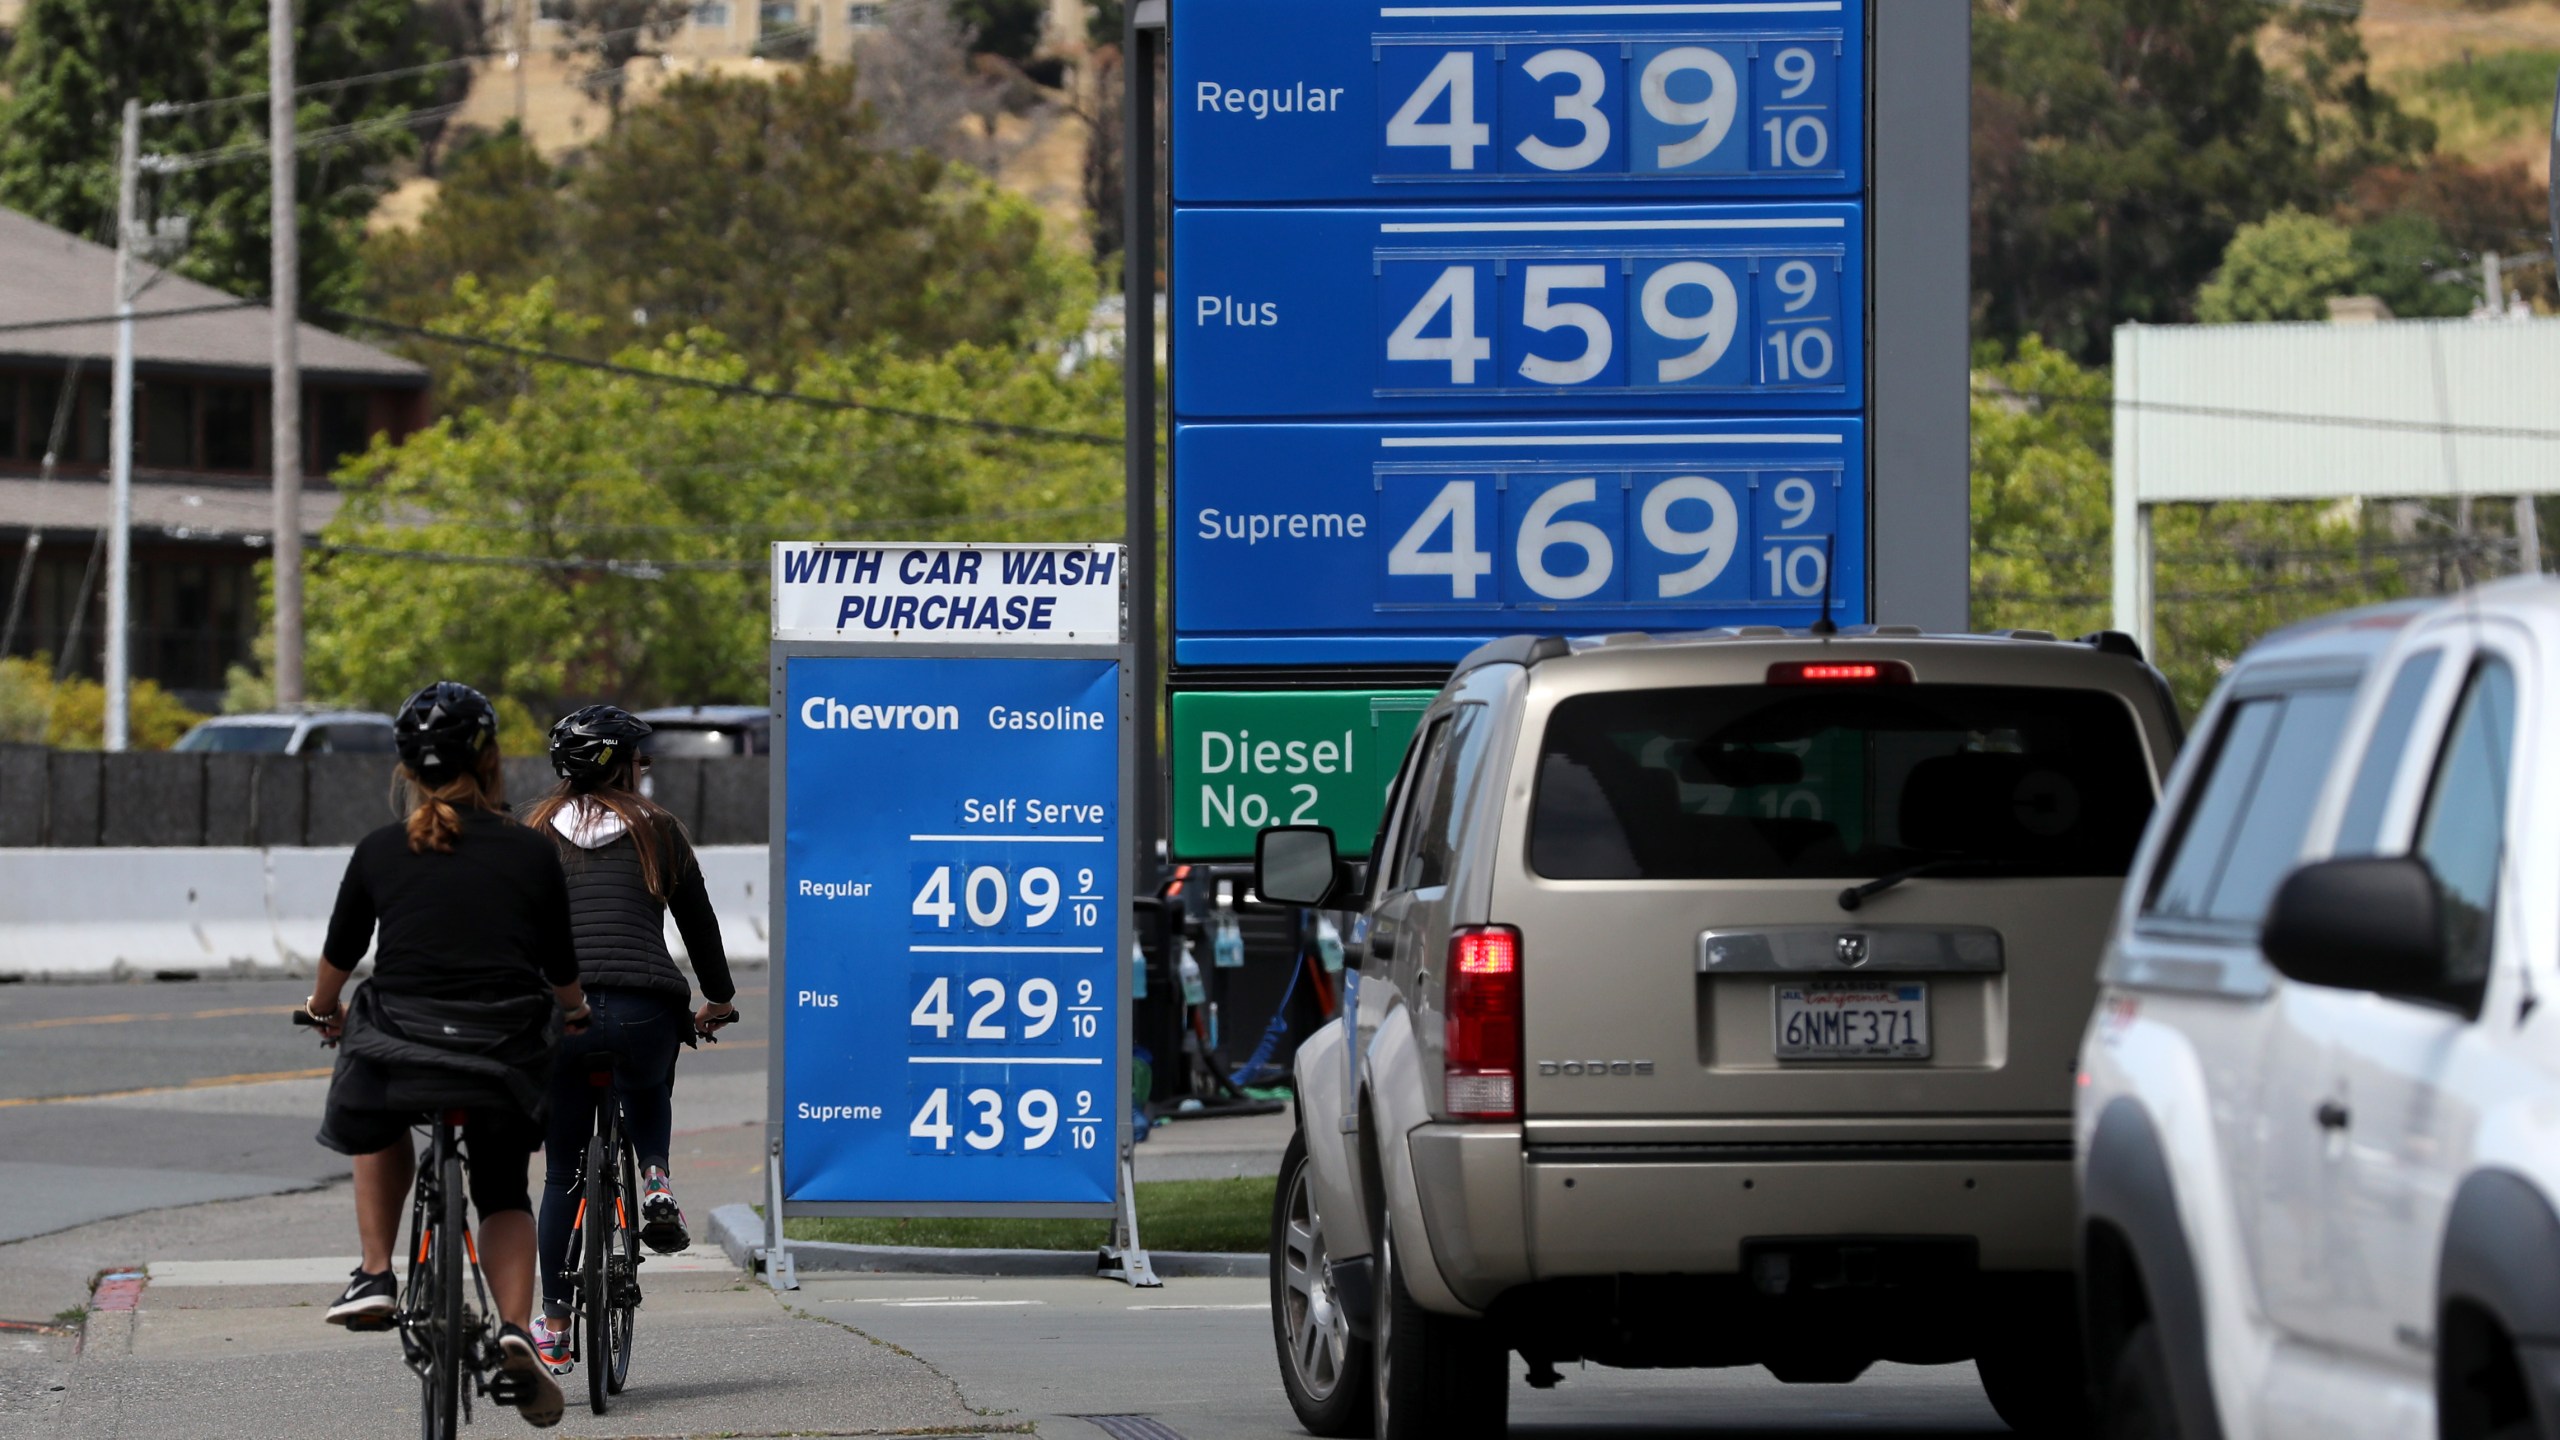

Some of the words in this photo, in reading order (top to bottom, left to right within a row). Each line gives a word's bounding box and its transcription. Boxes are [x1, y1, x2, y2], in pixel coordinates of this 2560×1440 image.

[1198, 81, 1344, 119] Regular
[1198, 296, 1277, 326] Plus
[1199, 508, 1367, 546] Supreme
[785, 550, 884, 585] WITH
[899, 550, 982, 585] CAR
[1003, 551, 1115, 586] WASH
[837, 595, 1056, 630] PURCHASE
[802, 697, 958, 730] Chevron
[989, 706, 1104, 730] Gasoline
[1202, 730, 1352, 773] Diesel
[964, 799, 1016, 822] Self
[1026, 799, 1103, 823] Serve
[800, 880, 872, 899] Regular
[799, 991, 838, 1007] Plus
[1786, 1010, 1918, 1045] 6NMF371
[1538, 1060, 1655, 1076] DODGE
[799, 1103, 881, 1122] Supreme
